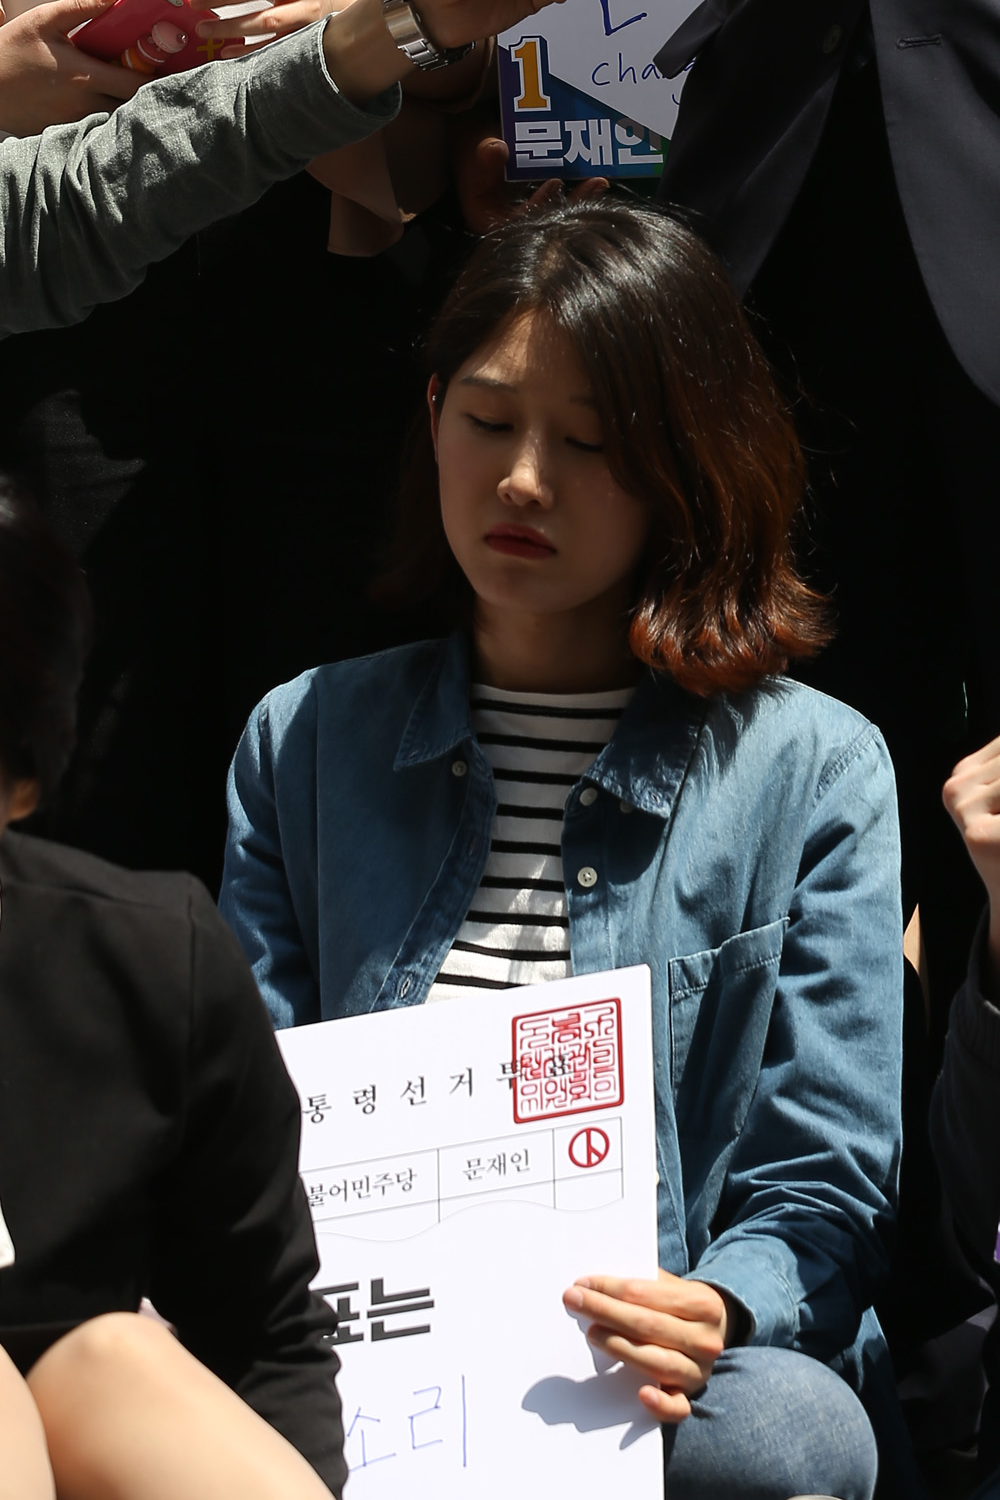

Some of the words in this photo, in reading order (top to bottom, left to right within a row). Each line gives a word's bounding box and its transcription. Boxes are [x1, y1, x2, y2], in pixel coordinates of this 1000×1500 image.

[507, 34, 552, 112] 1
[513, 117, 664, 170] 문재인
[462, 1148, 531, 1182] 문재인
